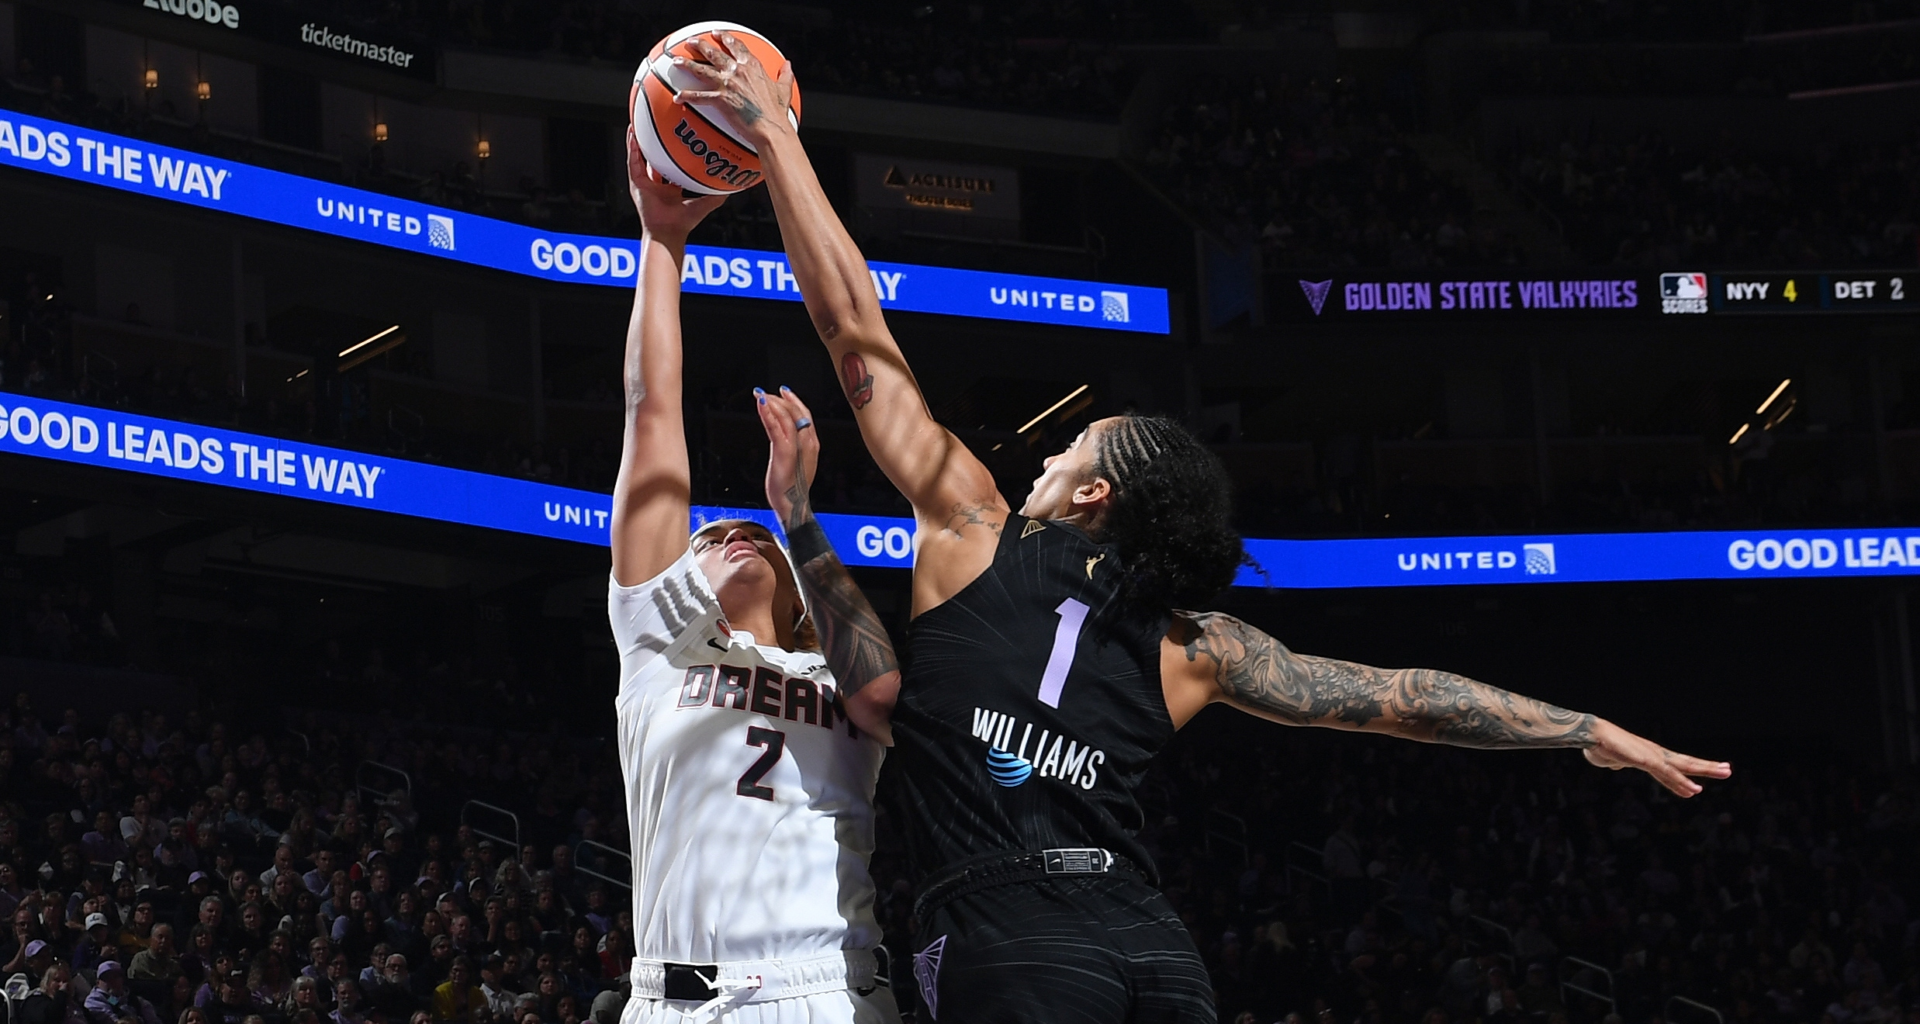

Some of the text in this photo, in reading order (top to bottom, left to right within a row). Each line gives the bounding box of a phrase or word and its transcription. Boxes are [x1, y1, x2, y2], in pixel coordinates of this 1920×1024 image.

[300, 23, 414, 68] ticketmaster
[76, 137, 143, 184] THE
[148, 153, 227, 200] WAY
[674, 117, 762, 188] Wilson
[317, 197, 421, 236] UNITED
[530, 238, 636, 278] GOOD
[681, 254, 753, 289] ADS
[757, 260, 800, 293] TH
[990, 287, 1095, 312] UNITED
[1344, 280, 1638, 311] GOLDEN STATE VALKYRIES
[1661, 299, 1709, 314] SCORES
[1726, 279, 1797, 302] NYY 4
[1834, 277, 1904, 300] DET 2
[107, 421, 225, 475] LEADS
[230, 442, 296, 486] THE
[301, 454, 381, 499] WAY
[544, 501, 609, 529] UNIT
[856, 525, 915, 559] GO
[1728, 538, 1838, 570] GOOD
[1398, 551, 1517, 571] UNITED
[1037, 596, 1091, 709] 1
[736, 725, 786, 801] 2
[971, 706, 1106, 790] WILLIAMS
